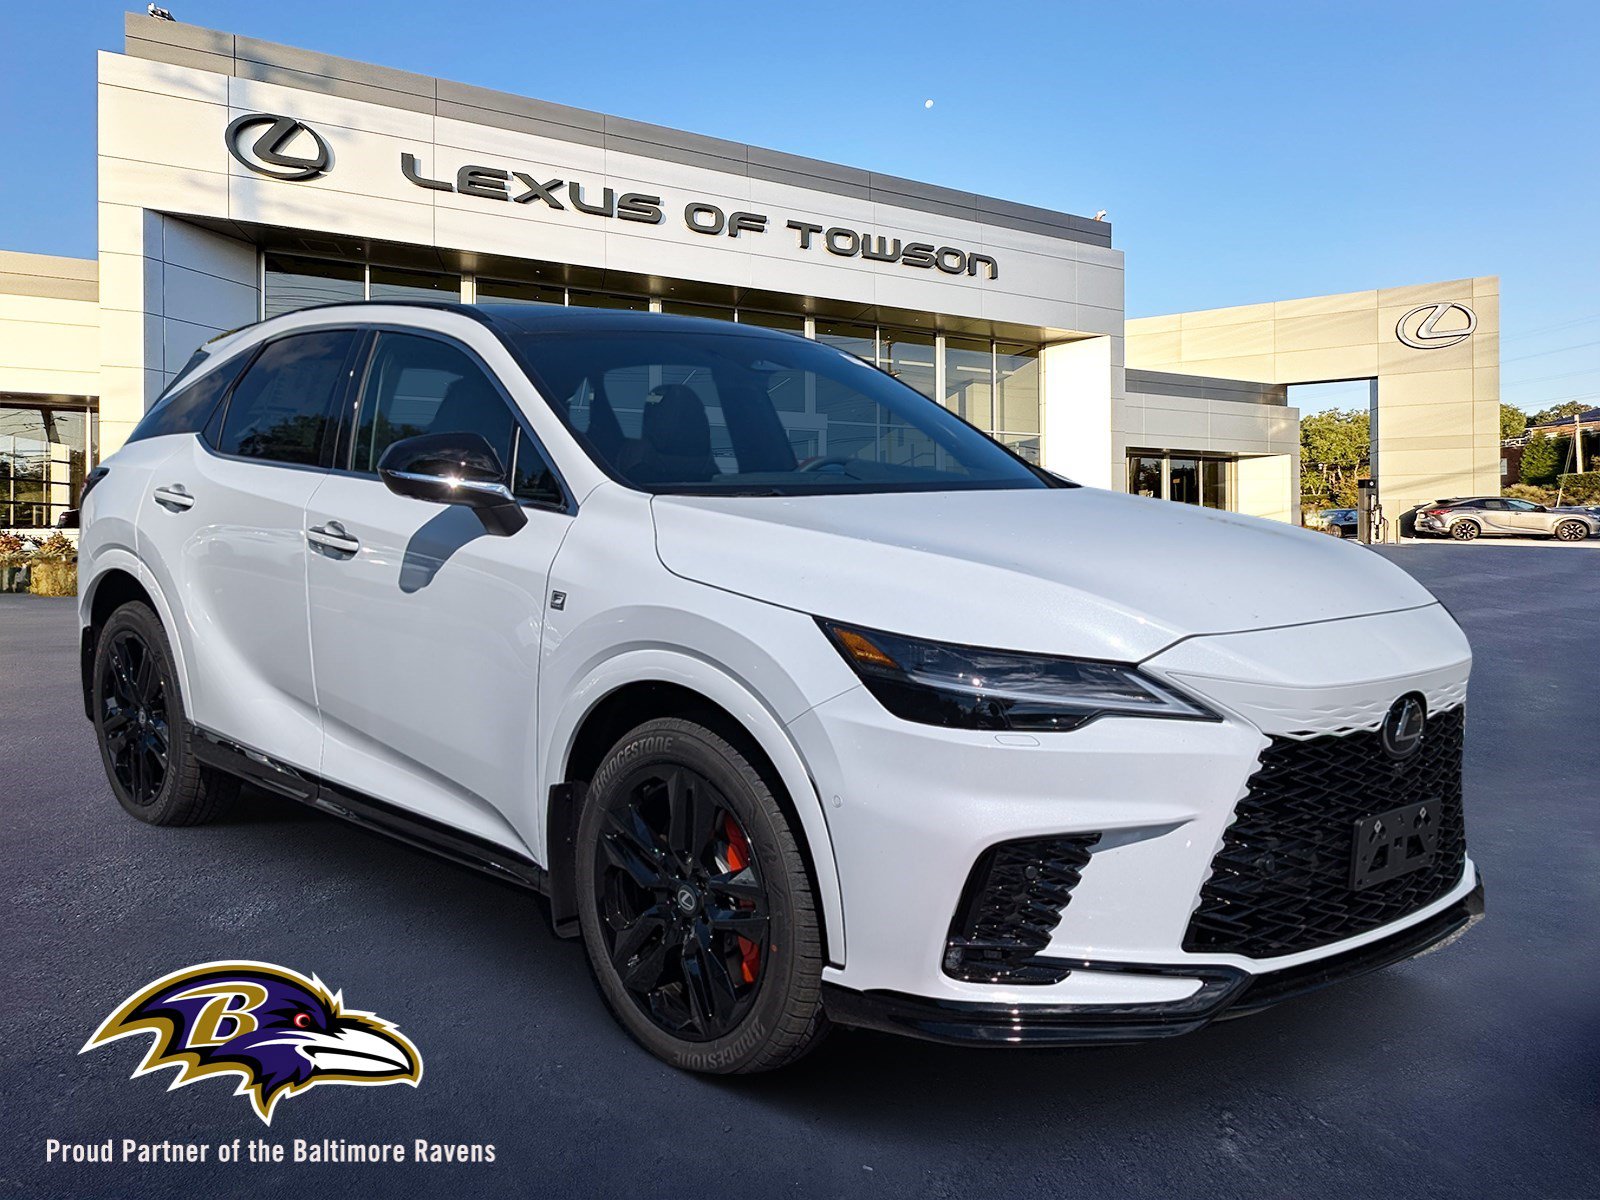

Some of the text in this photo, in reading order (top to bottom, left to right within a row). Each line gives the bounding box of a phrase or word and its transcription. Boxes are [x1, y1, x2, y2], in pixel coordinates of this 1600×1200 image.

[400, 152, 999, 280] LEXUS OF TOWSON
[592, 736, 674, 801] BRIDGESTONE
